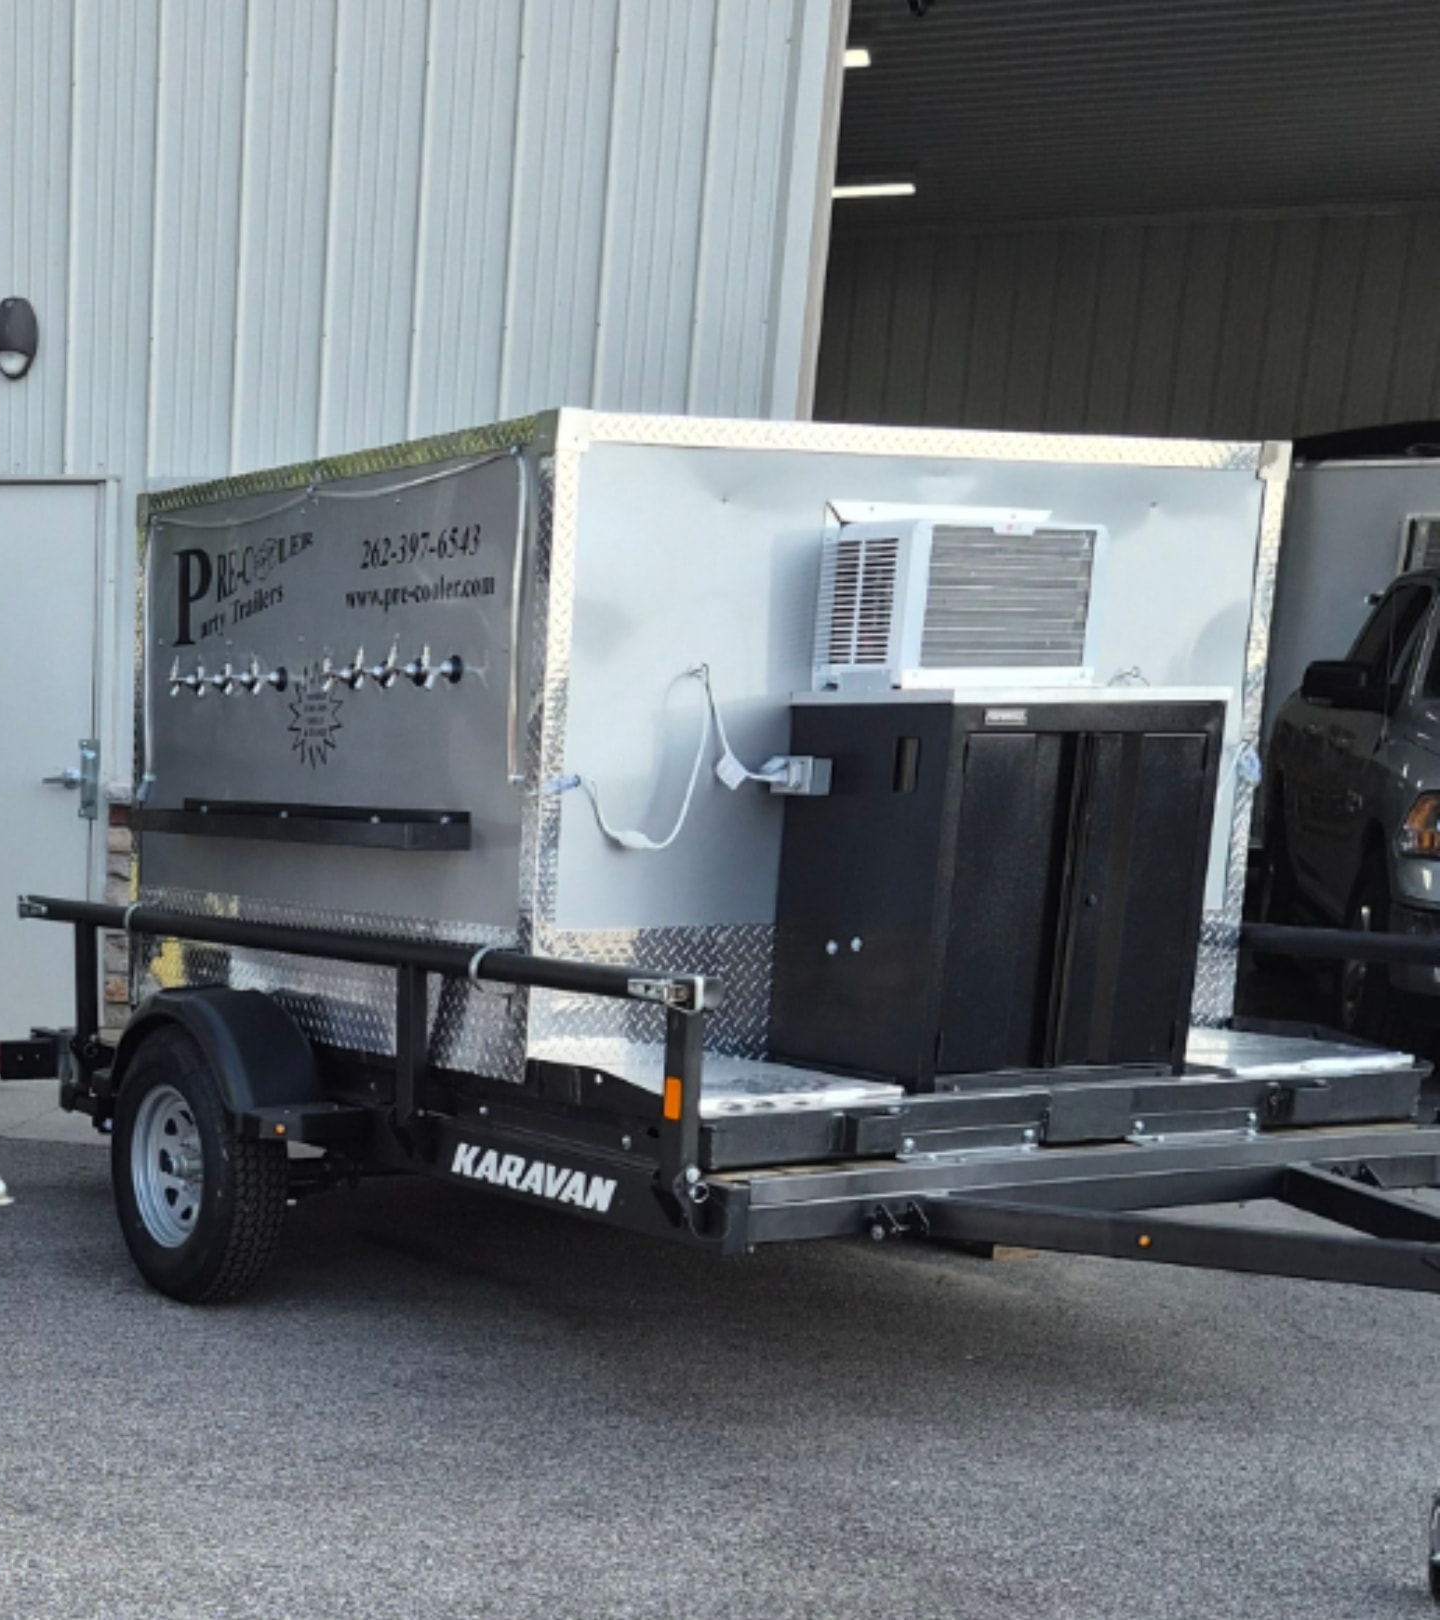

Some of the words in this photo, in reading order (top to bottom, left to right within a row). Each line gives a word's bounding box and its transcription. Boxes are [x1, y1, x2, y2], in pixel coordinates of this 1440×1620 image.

[361, 523, 481, 569] 262-397-6543
[231, 584, 283, 624] Trailers
[345, 574, 495, 614] www.pre-cooler.com
[451, 1142, 618, 1213] KARAVAN
